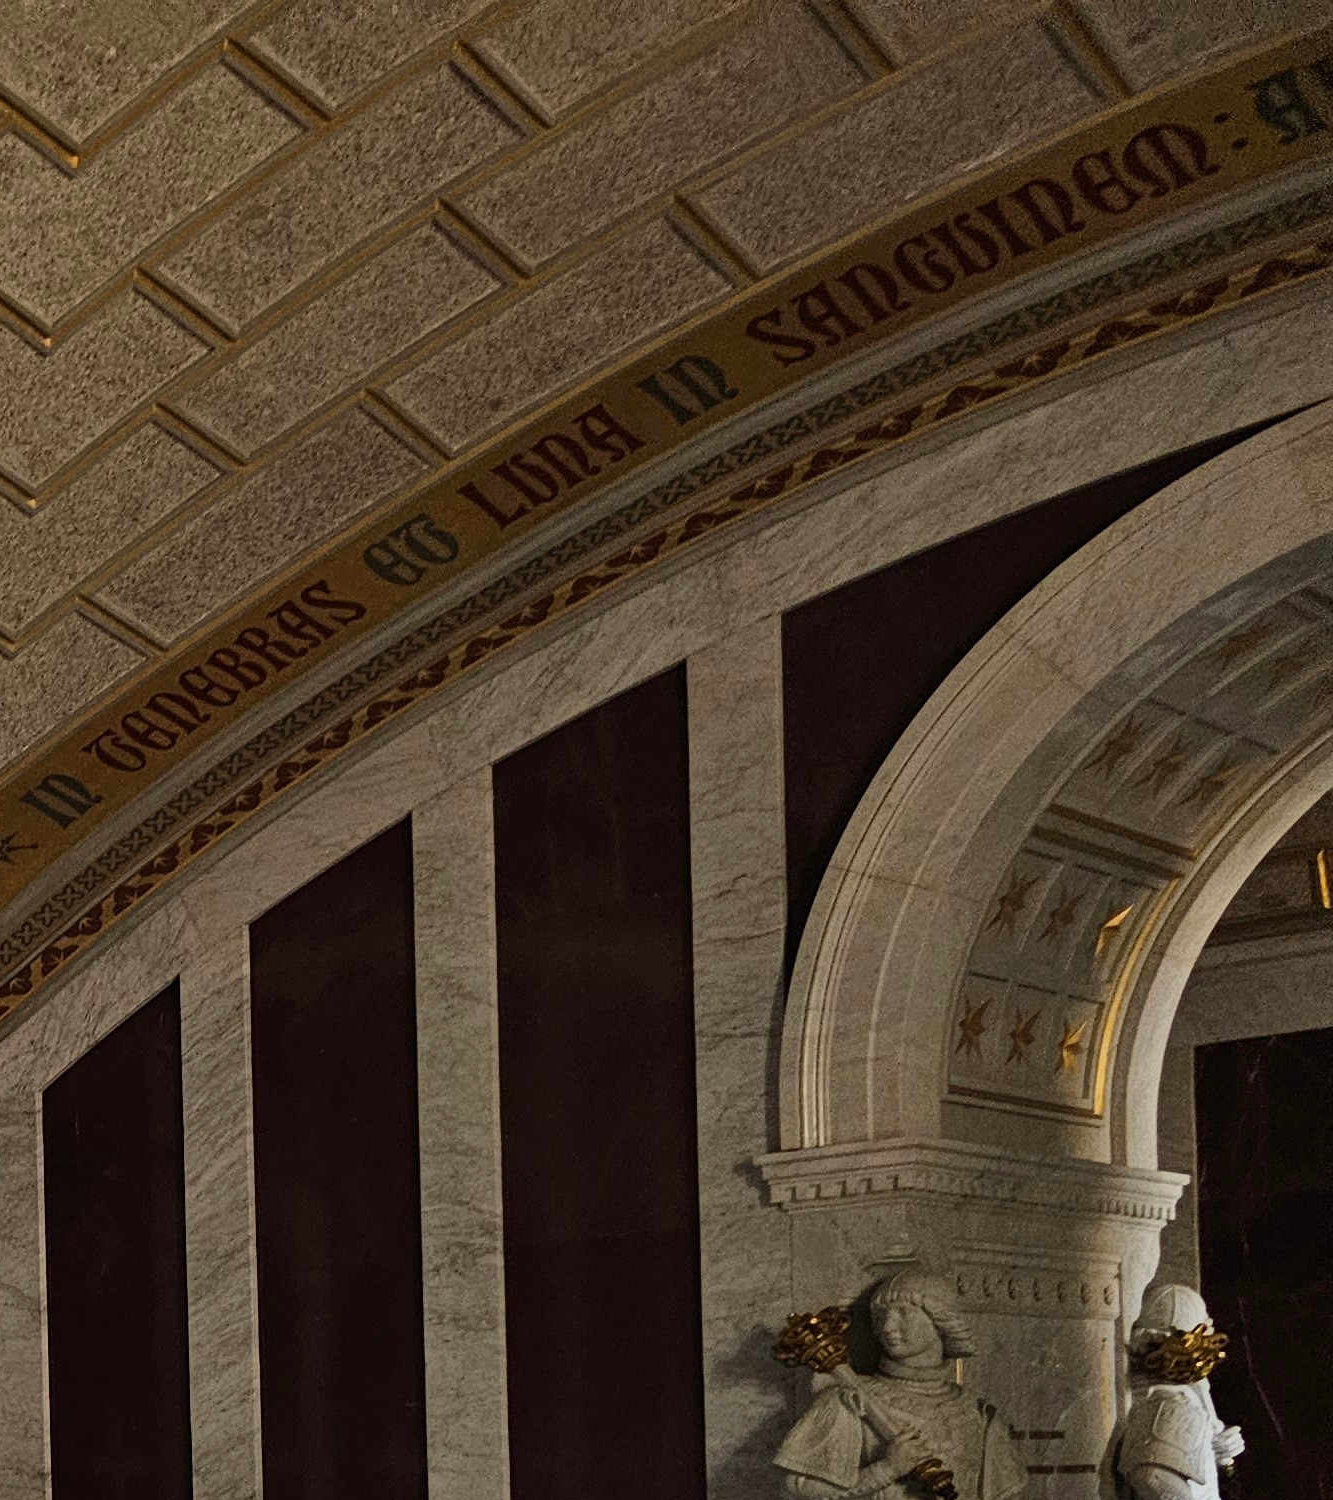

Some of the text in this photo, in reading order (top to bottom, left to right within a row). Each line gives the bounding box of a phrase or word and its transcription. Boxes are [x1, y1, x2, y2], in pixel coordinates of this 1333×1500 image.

[19, 772, 102, 830] IN
[81, 578, 369, 776] TENEBRAS
[360, 511, 461, 588] ET
[455, 402, 647, 531] LUNA
[636, 355, 740, 427] IN
